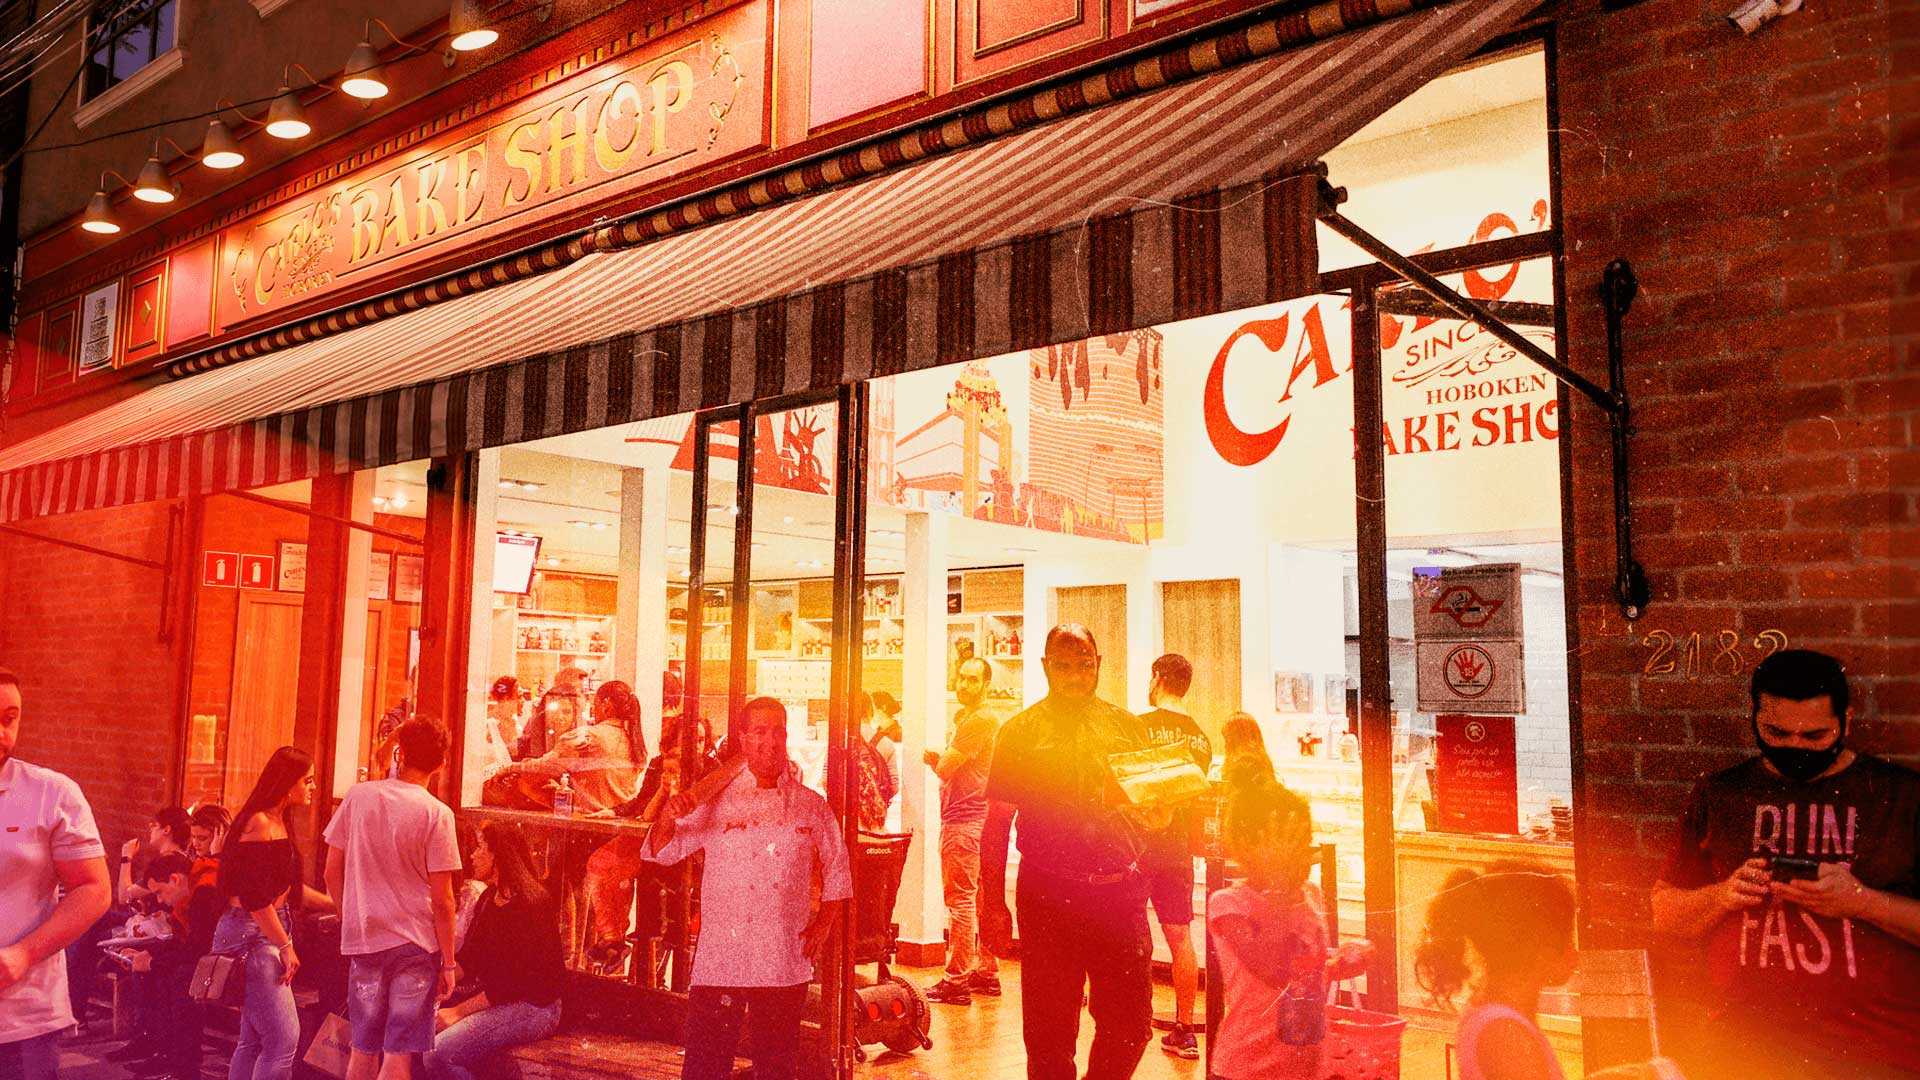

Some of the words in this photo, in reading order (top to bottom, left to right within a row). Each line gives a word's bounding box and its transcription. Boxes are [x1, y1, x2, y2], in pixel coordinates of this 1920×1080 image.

[348, 139, 488, 264] BAKE
[501, 60, 694, 207] SHOP
[1406, 318, 1487, 367] SINC
[1426, 372, 1547, 405] HOBOKEN
[1349, 410, 1462, 459] AKE
[1148, 726, 1174, 745] Lake
[1753, 803, 1857, 855] RUN
